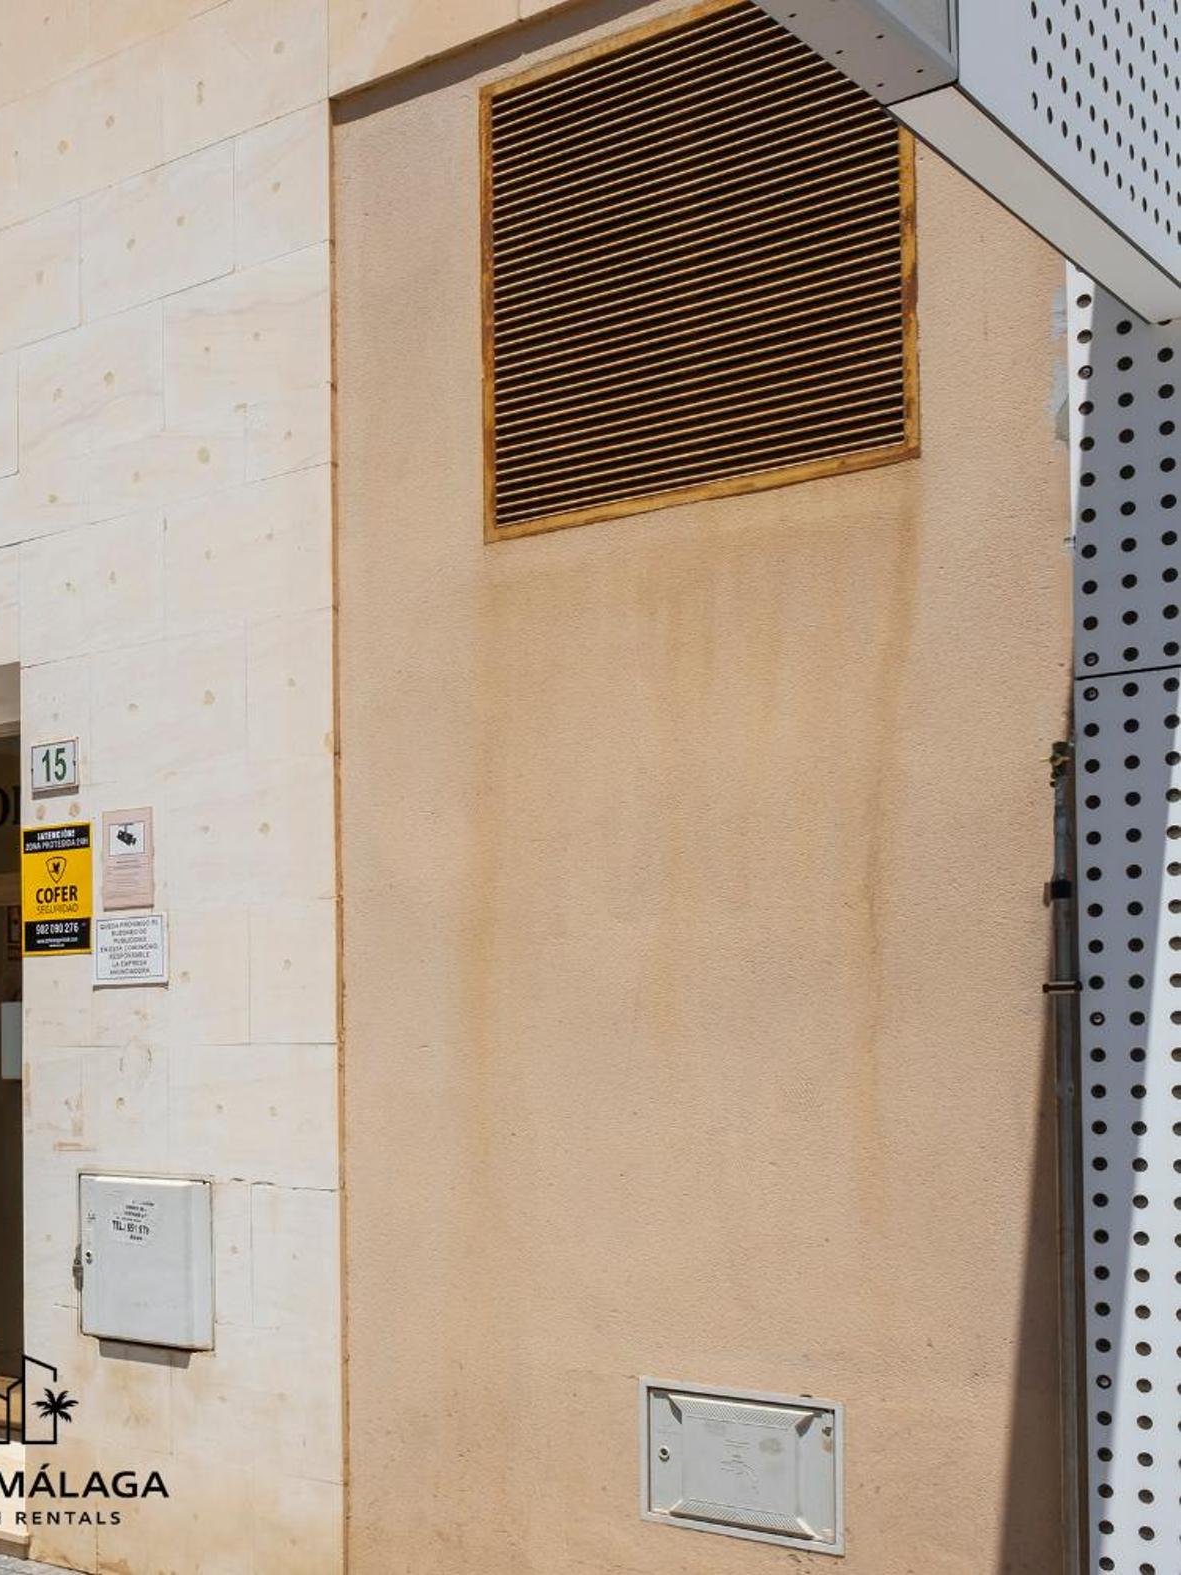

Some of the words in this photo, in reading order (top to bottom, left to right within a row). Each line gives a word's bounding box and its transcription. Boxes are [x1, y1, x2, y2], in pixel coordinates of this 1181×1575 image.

[41, 747, 67, 782] 15
[35, 884, 78, 904] COFER
[36, 903, 79, 915] SEGURIDAD
[64, 921, 79, 934] 276
